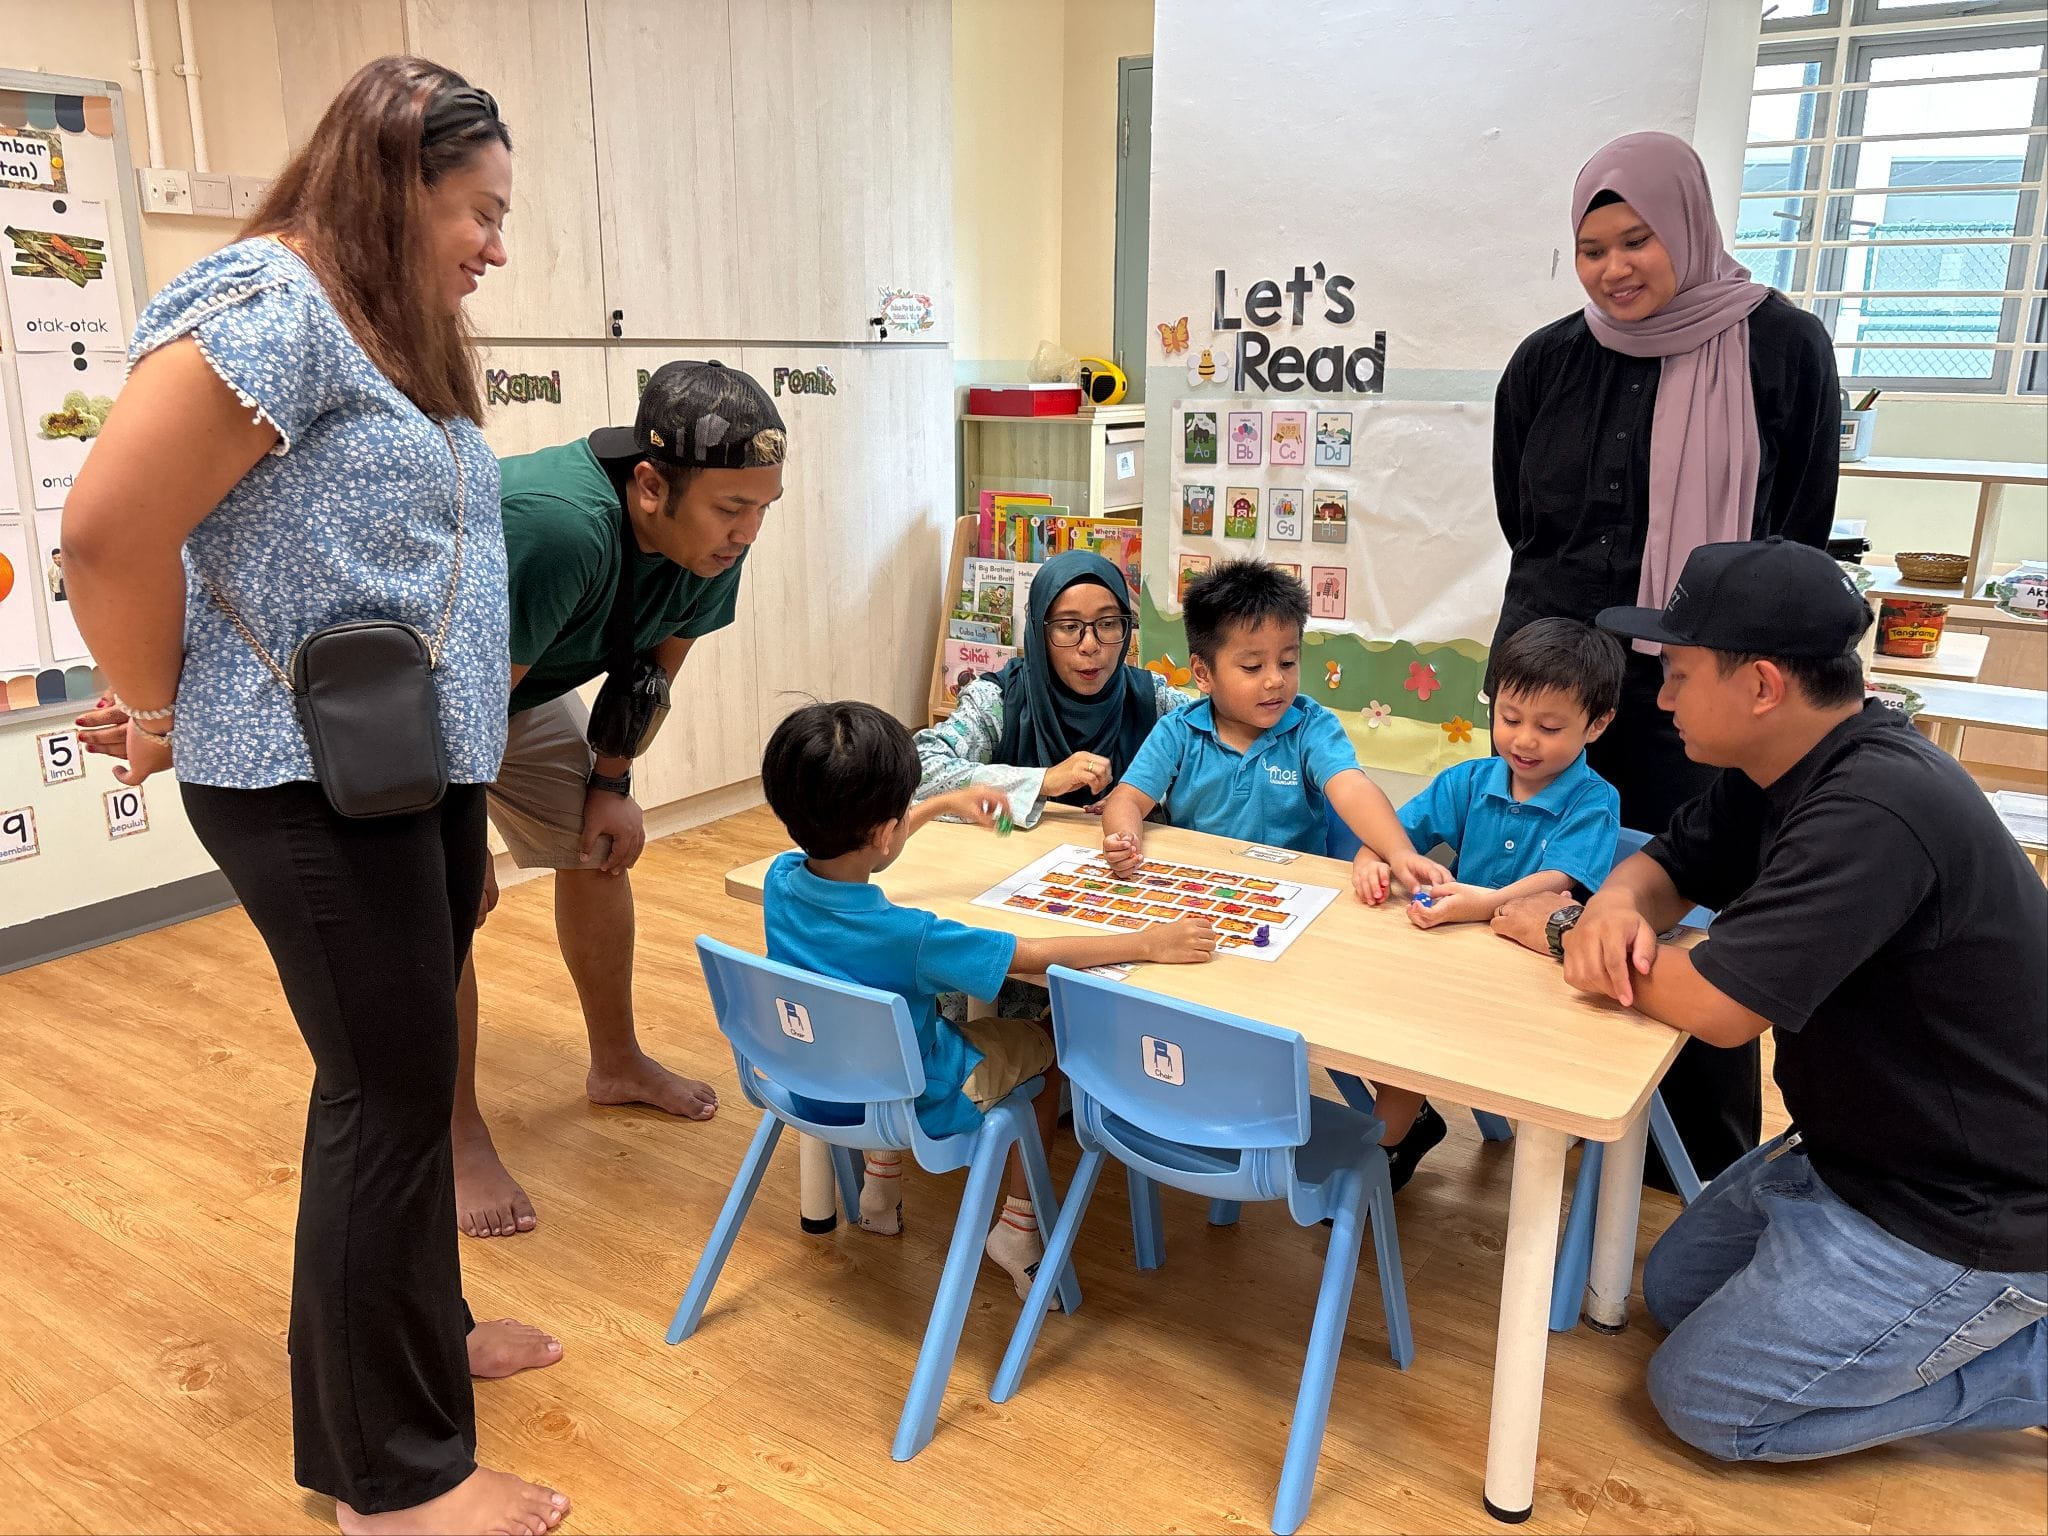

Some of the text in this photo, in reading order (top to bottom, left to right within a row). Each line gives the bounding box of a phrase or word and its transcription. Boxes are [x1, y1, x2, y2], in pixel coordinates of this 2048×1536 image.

[1213, 261, 1355, 330] Let's
[27, 318, 108, 333] otak-otak
[1234, 330, 1386, 393] Read
[486, 368, 561, 406] Kami
[1193, 442, 1210, 458] Aa
[1236, 443, 1253, 460] Bb
[1279, 443, 1296, 460] Cc
[1324, 445, 1341, 460] Dd
[43, 474, 78, 488] ond
[1191, 515, 1205, 531] Ee
[1234, 517, 1248, 533] Ff
[1276, 520, 1295, 537] Gg
[1321, 521, 1338, 537] Hh
[978, 564, 989, 572] Big
[981, 573, 997, 581] Little
[1890, 629, 1936, 638] Tangrams
[959, 647, 989, 664] Sihat
[49, 736, 72, 767] 5
[50, 768, 74, 779] lima
[113, 793, 138, 819] 10
[3, 813, 27, 843] 9
[1154, 1068, 1173, 1080] Chair
